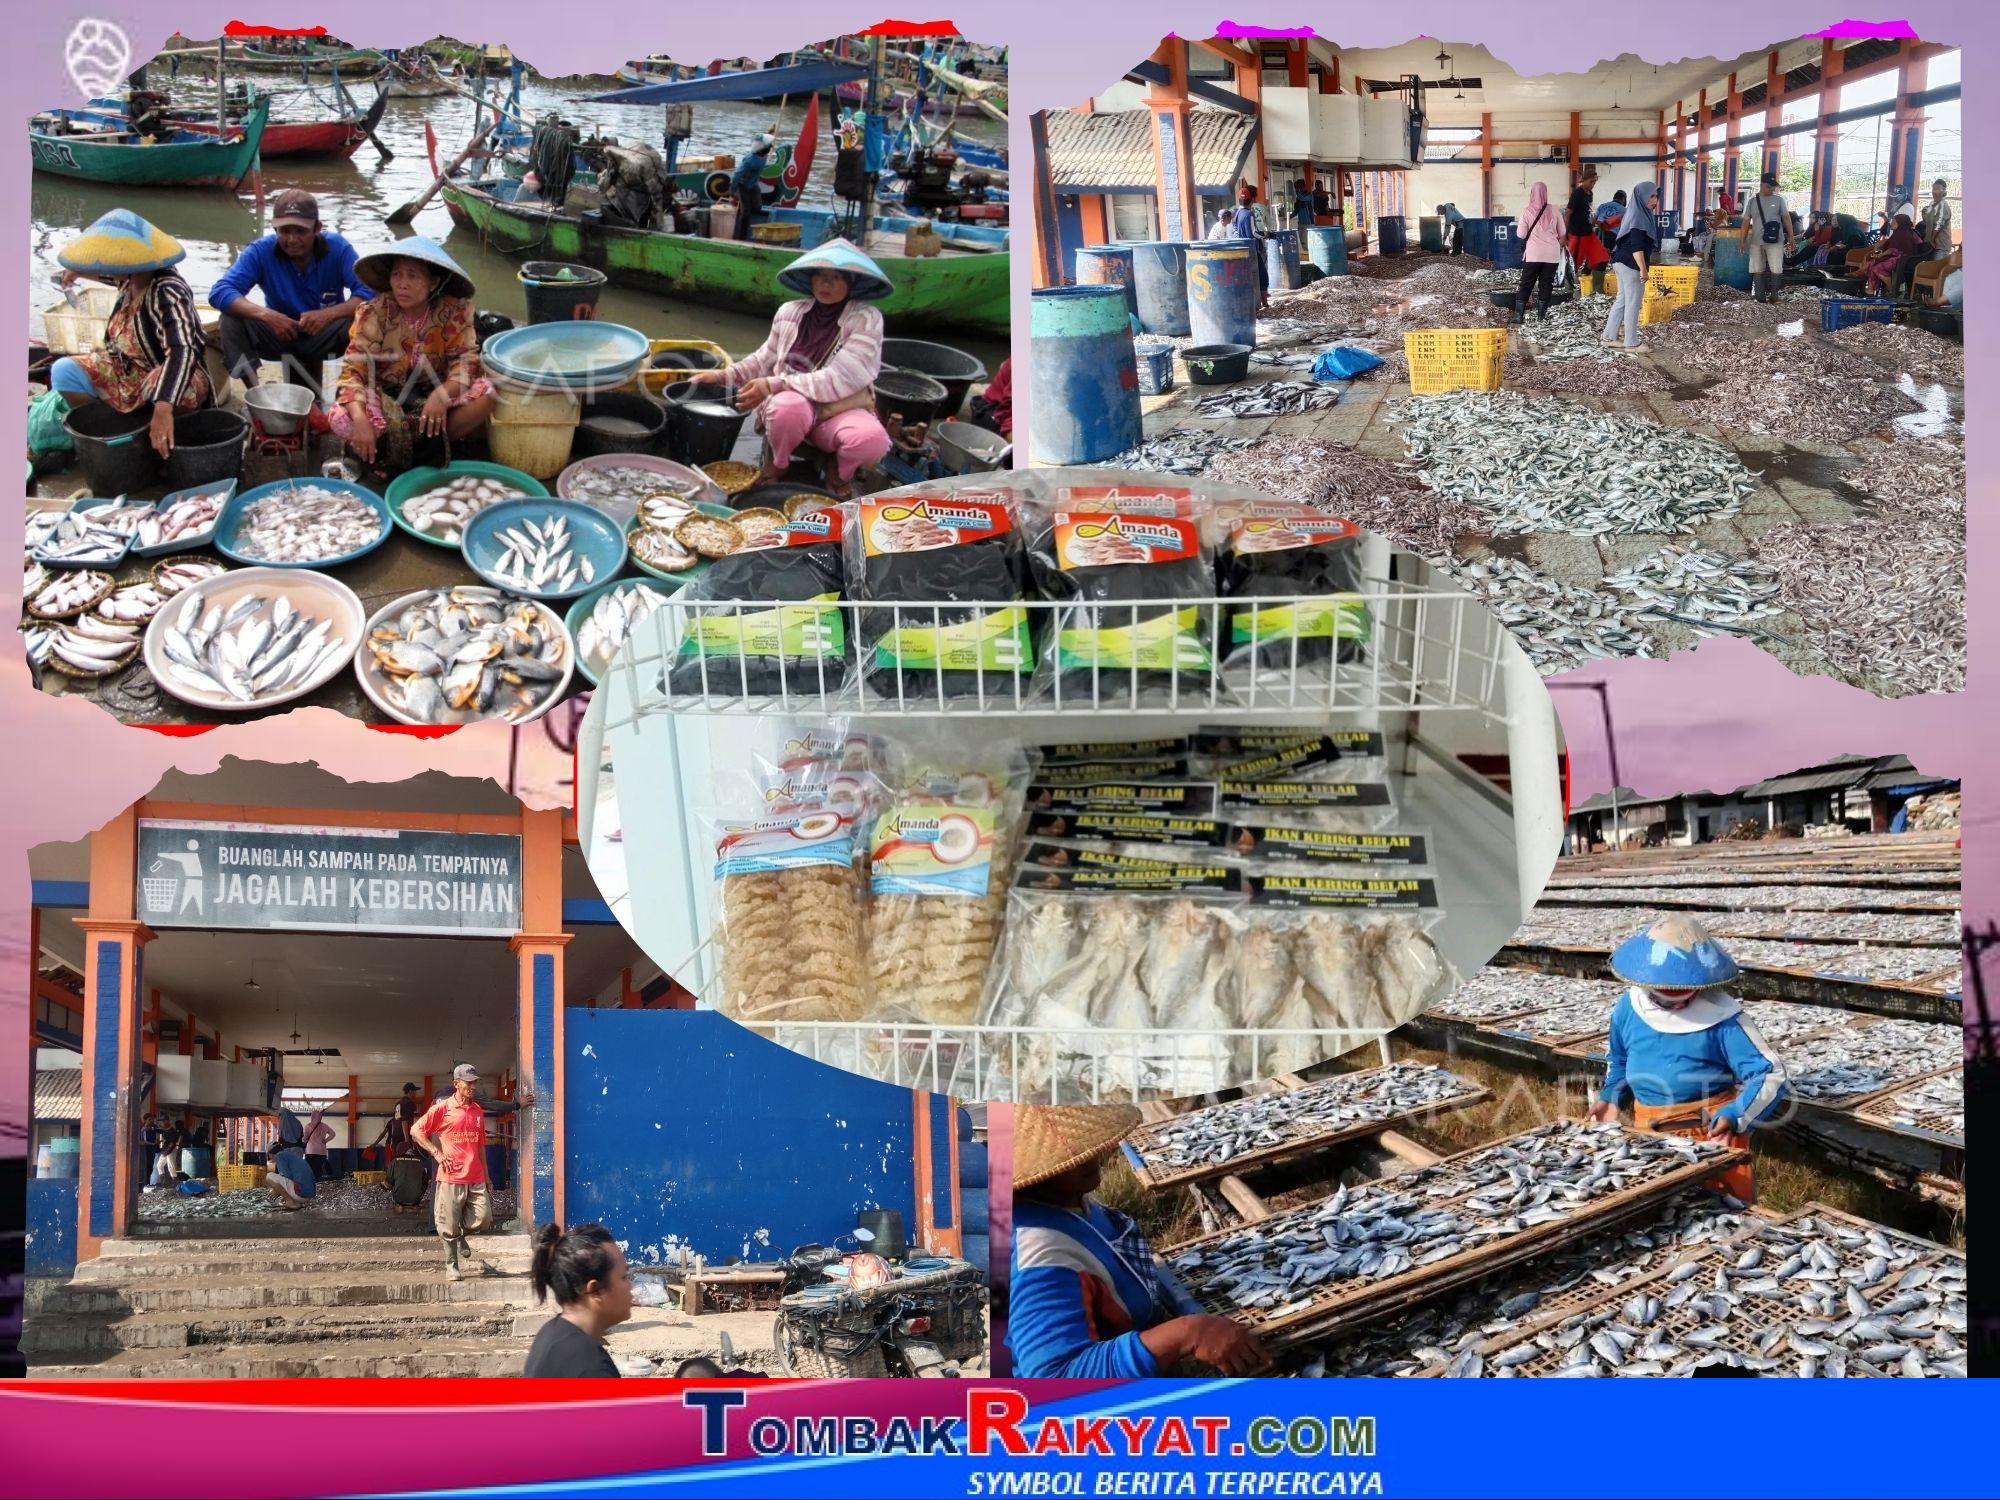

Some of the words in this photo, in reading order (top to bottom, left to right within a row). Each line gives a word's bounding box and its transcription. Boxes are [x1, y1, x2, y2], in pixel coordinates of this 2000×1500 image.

[882, 502, 988, 522] Amanda
[1076, 518, 1179, 539] Amanda
[766, 779, 829, 801] Amanda
[879, 814, 940, 840] Amanda
[1077, 815, 1110, 826] IKAN
[1113, 817, 1166, 830] KERING
[1168, 820, 1215, 832] BELAH
[1264, 828, 1300, 841] IKAN
[1303, 832, 1358, 846] KERING
[1361, 836, 1411, 848] BELAH
[218, 846, 304, 868] BUANGLAH
[308, 850, 374, 870] SAMPAH
[378, 853, 418, 873] PADA
[422, 854, 510, 876] TEMPATNYA
[1072, 872, 1110, 882] IKAN
[1113, 871, 1172, 881] KERING
[1175, 868, 1227, 879] BELAH
[1263, 876, 1301, 889] IKAN
[1305, 877, 1363, 891] KERING
[1367, 880, 1420, 891] BELAH
[213, 872, 338, 908] JAGALAH
[348, 877, 514, 914] KEBERSIHAN
